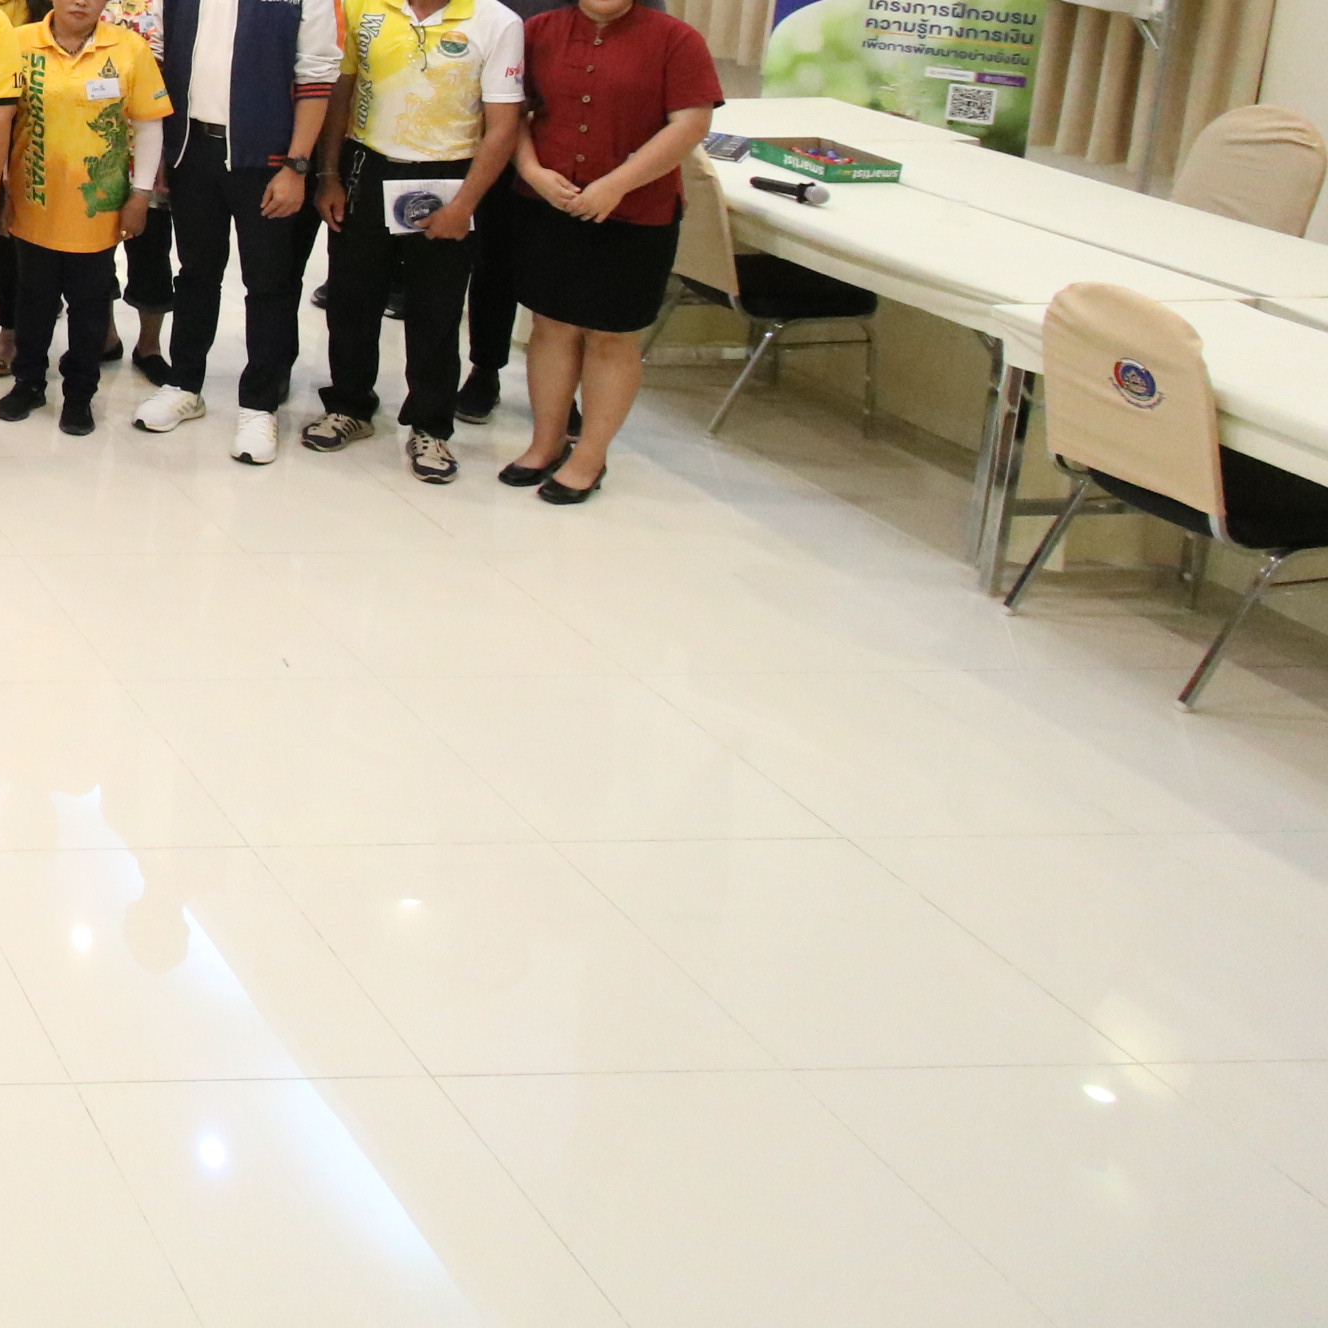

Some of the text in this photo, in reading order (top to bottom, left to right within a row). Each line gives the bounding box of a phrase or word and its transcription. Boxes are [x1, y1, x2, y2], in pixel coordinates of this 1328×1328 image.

[865, 17, 1034, 45] ความรู้ทางการเงิน
[29, 53, 46, 208] SUKHOTHAI
